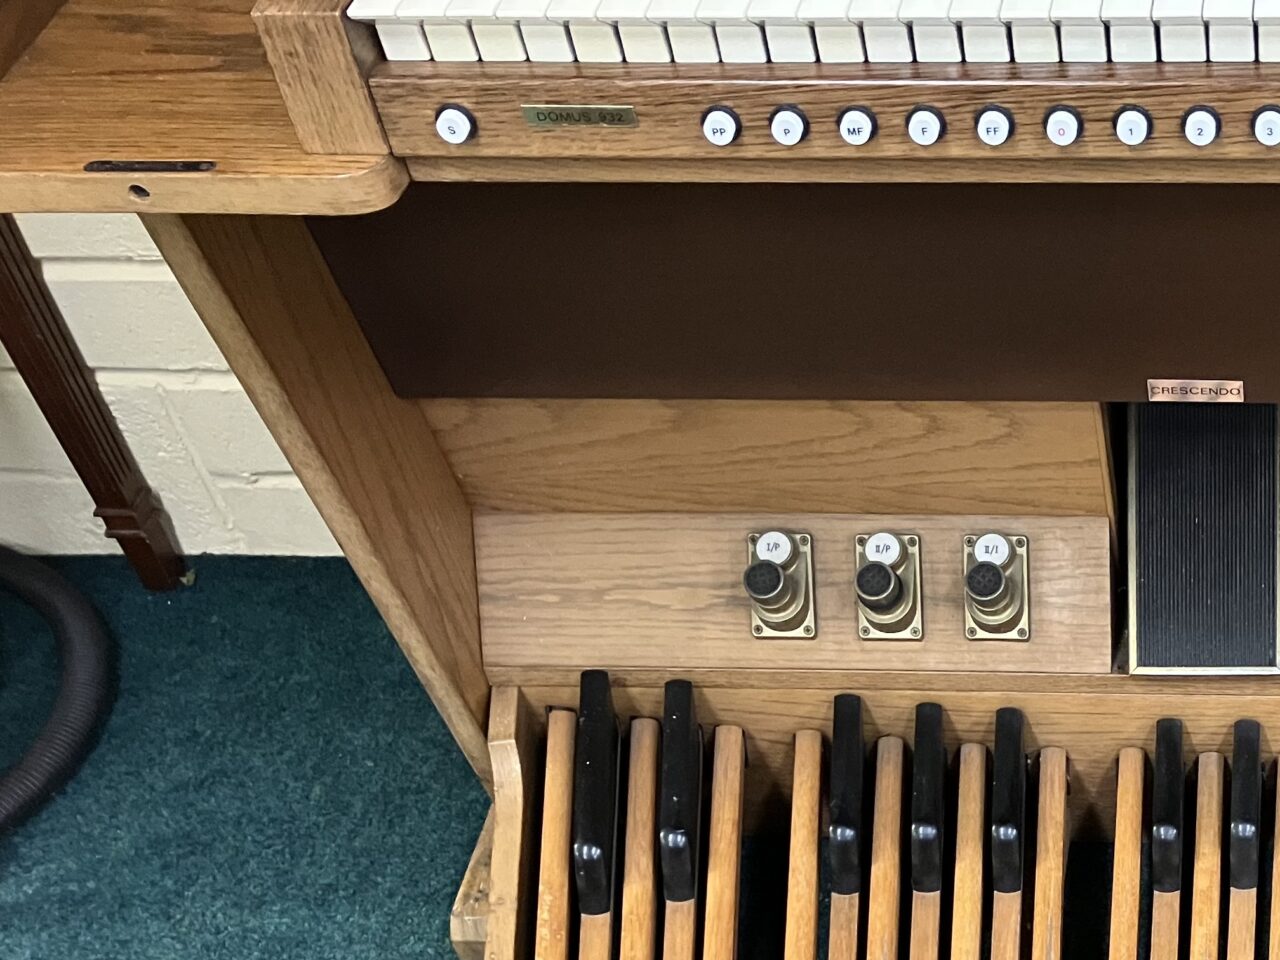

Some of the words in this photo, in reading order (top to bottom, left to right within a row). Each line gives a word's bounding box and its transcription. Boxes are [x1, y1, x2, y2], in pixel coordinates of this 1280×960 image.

[536, 111, 592, 123] DOMUS
[598, 112, 625, 122] 932
[447, 126, 456, 135] S
[712, 128, 727, 137] PP
[783, 128, 791, 137] P
[847, 128, 864, 137] MF
[921, 127, 928, 136] F
[986, 127, 1000, 136] FF
[1128, 128, 1134, 136] 1
[1197, 128, 1204, 137] 2
[1266, 128, 1273, 137] 3
[1150, 386, 1241, 396] CRESCENDO
[766, 542, 780, 552] I/P
